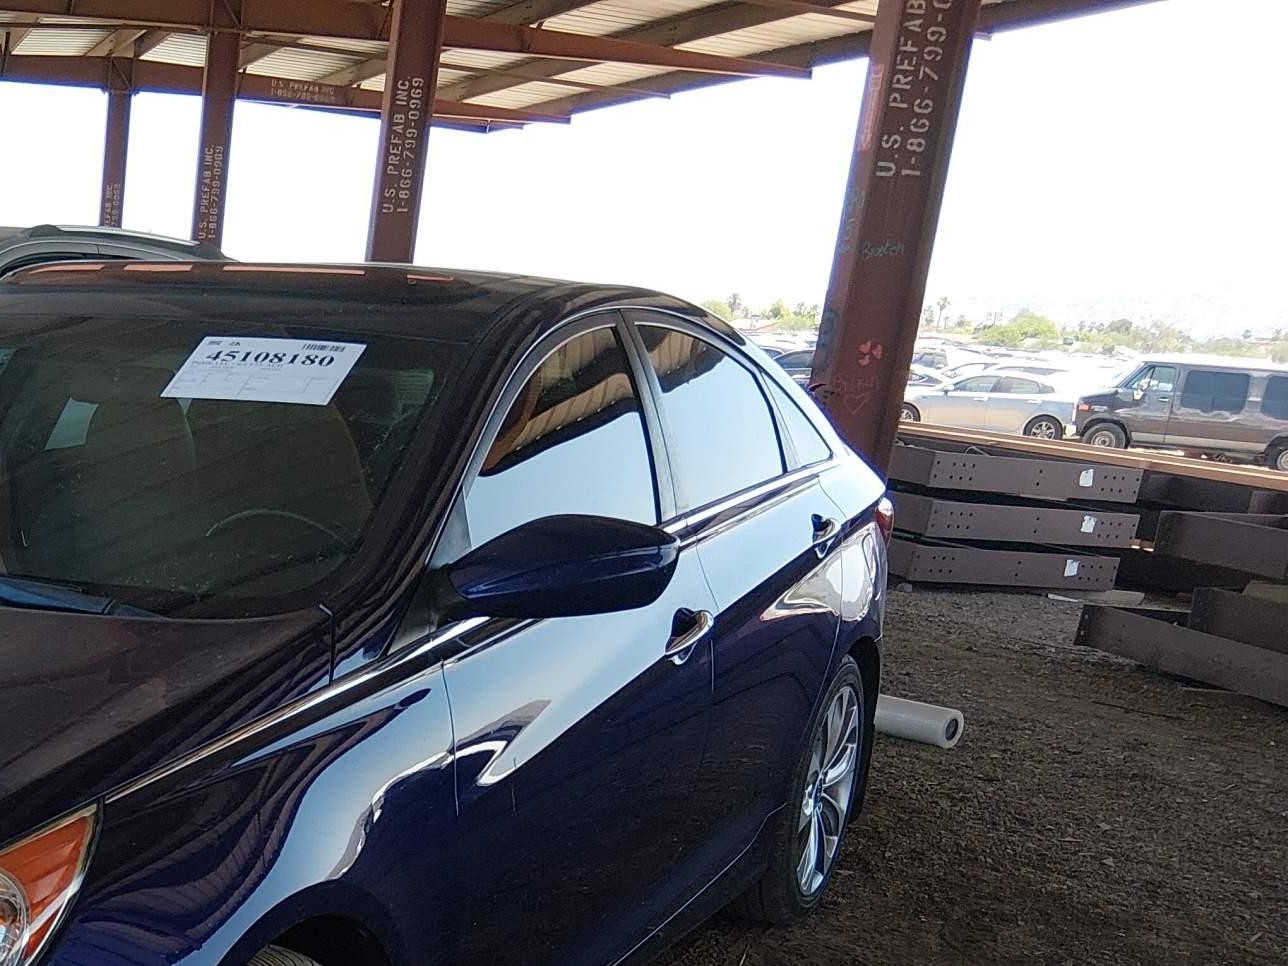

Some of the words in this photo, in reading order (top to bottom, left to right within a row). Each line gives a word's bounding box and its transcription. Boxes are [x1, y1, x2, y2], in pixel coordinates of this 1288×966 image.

[888, 0, 926, 108] PREFAB
[395, 76, 410, 105] INC.
[203, 145, 214, 166] INC.
[387, 113, 405, 174] PREFAB
[397, 77, 424, 212] 1-866-799-0969
[876, 126, 903, 177] U.S.
[200, 170, 211, 213] PREFAB
[382, 183, 397, 213] U.S.
[198, 217, 207, 239] U.S.
[206, 350, 335, 367] 45108180
